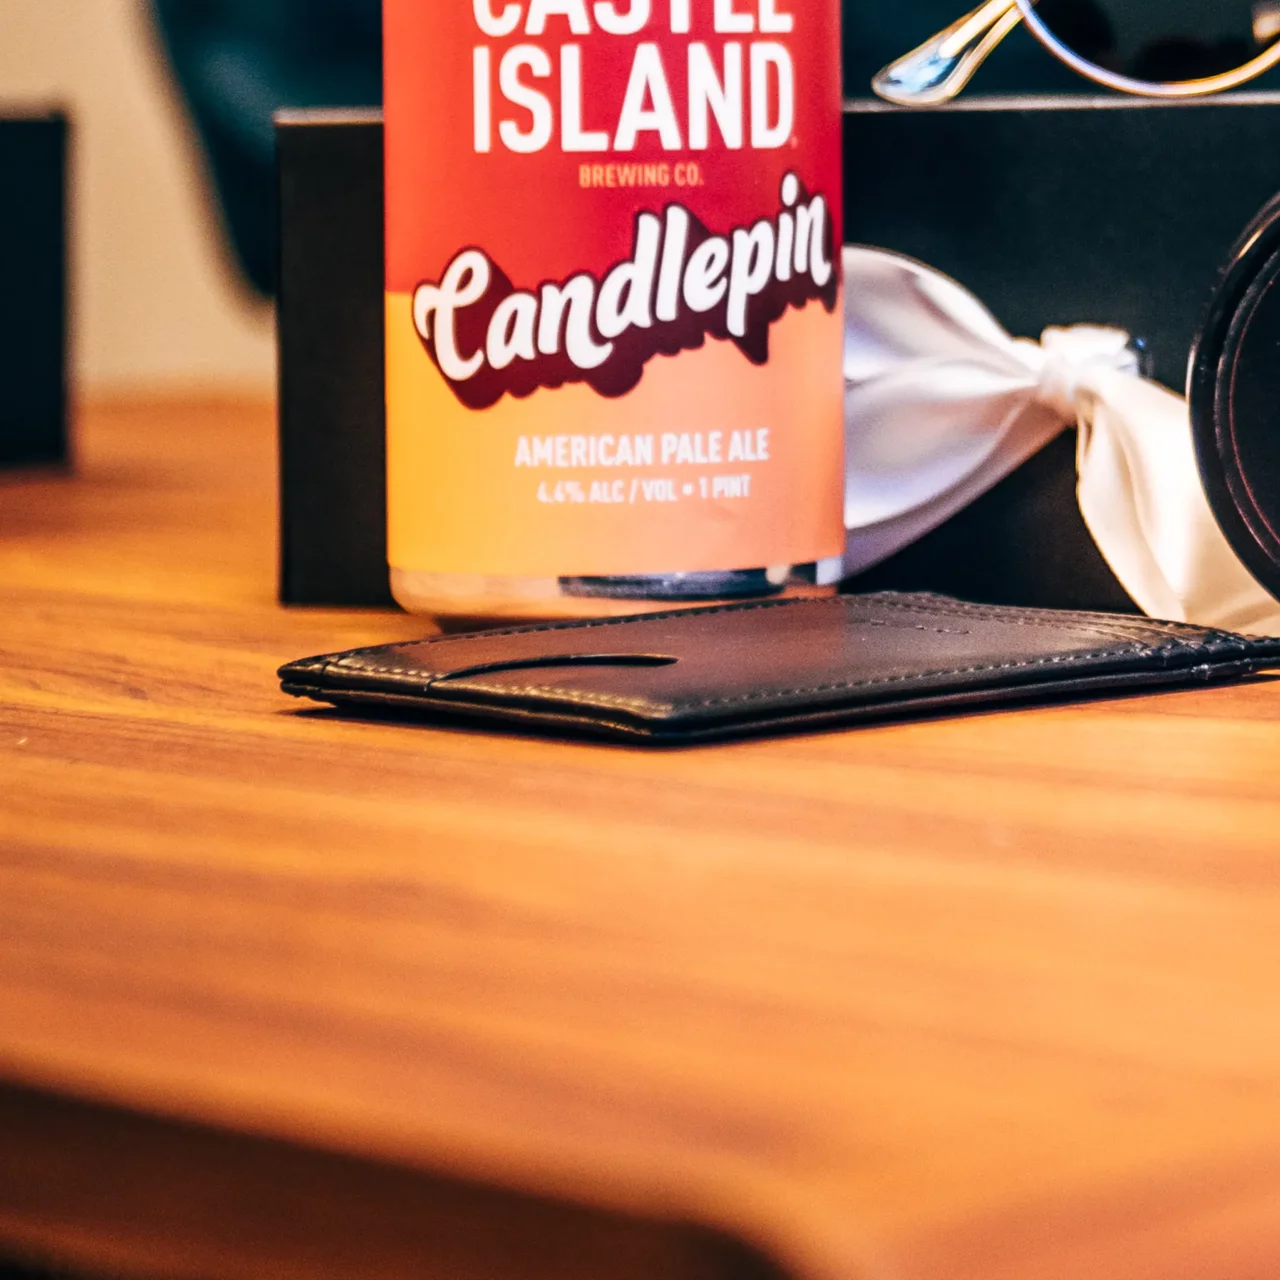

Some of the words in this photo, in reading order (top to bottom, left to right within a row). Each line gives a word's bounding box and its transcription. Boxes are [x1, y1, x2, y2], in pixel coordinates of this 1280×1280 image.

[472, 41, 795, 153] ISLAND
[578, 164, 670, 189] BREWING
[673, 163, 705, 187] CO.
[412, 171, 833, 382] Candlepin
[514, 432, 654, 467] AMERICAN
[660, 430, 722, 465] PALE
[727, 427, 770, 462] ALE
[589, 478, 625, 503] ALC
[641, 477, 677, 503] VOL
[712, 474, 752, 498] PINT
